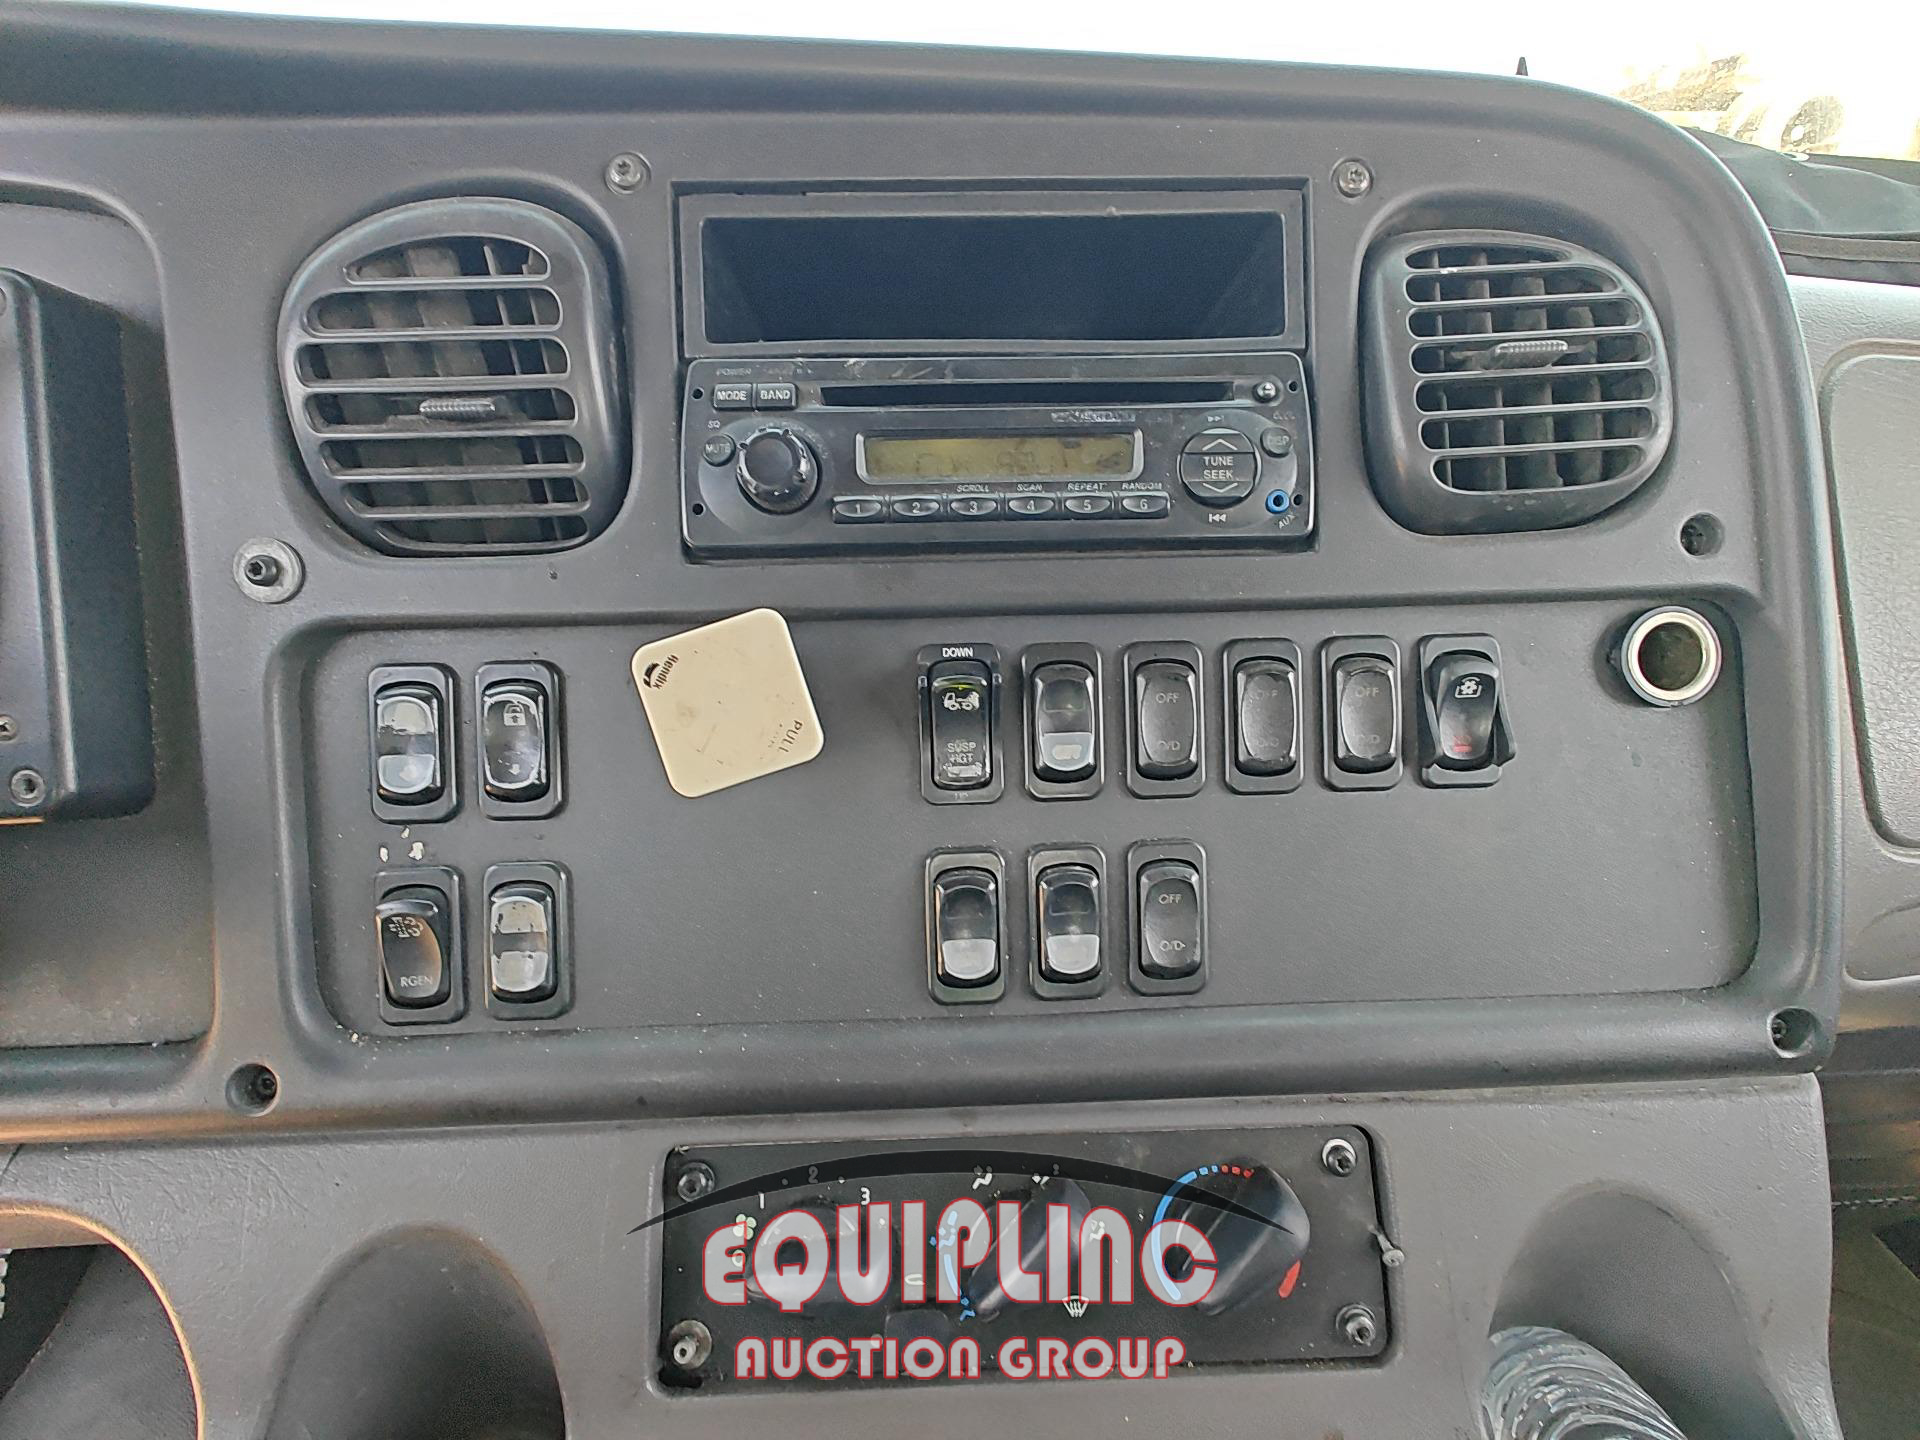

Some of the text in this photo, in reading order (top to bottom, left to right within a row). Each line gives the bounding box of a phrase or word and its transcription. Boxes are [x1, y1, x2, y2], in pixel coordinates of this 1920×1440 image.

[717, 390, 747, 401] MODE
[759, 389, 791, 400] BAND
[705, 443, 731, 454] MUTE
[1203, 456, 1234, 466] TUNE
[1203, 469, 1234, 480] SEEK
[956, 484, 990, 493] SCROLL
[1017, 483, 1043, 492] SCAN
[1067, 482, 1106, 491] REPEAT
[1122, 482, 1162, 491] RANDOM
[912, 501, 921, 514] 2
[969, 500, 977, 513] 3
[1026, 500, 1035, 511] 4
[1083, 499, 1092, 511] 5
[1140, 498, 1148, 510] 6
[1278, 512, 1296, 529] AUX
[942, 647, 973, 658] DOWN
[1355, 686, 1380, 698] OFF
[1155, 692, 1179, 704] OFF
[778, 719, 803, 753] PULL
[947, 742, 977, 753] SUSP
[1158, 893, 1182, 904] OFF
[400, 975, 433, 988] RGEN
[808, 1165, 819, 1184] 2
[757, 1191, 765, 1210] 1
[860, 1186, 871, 1206] 3
